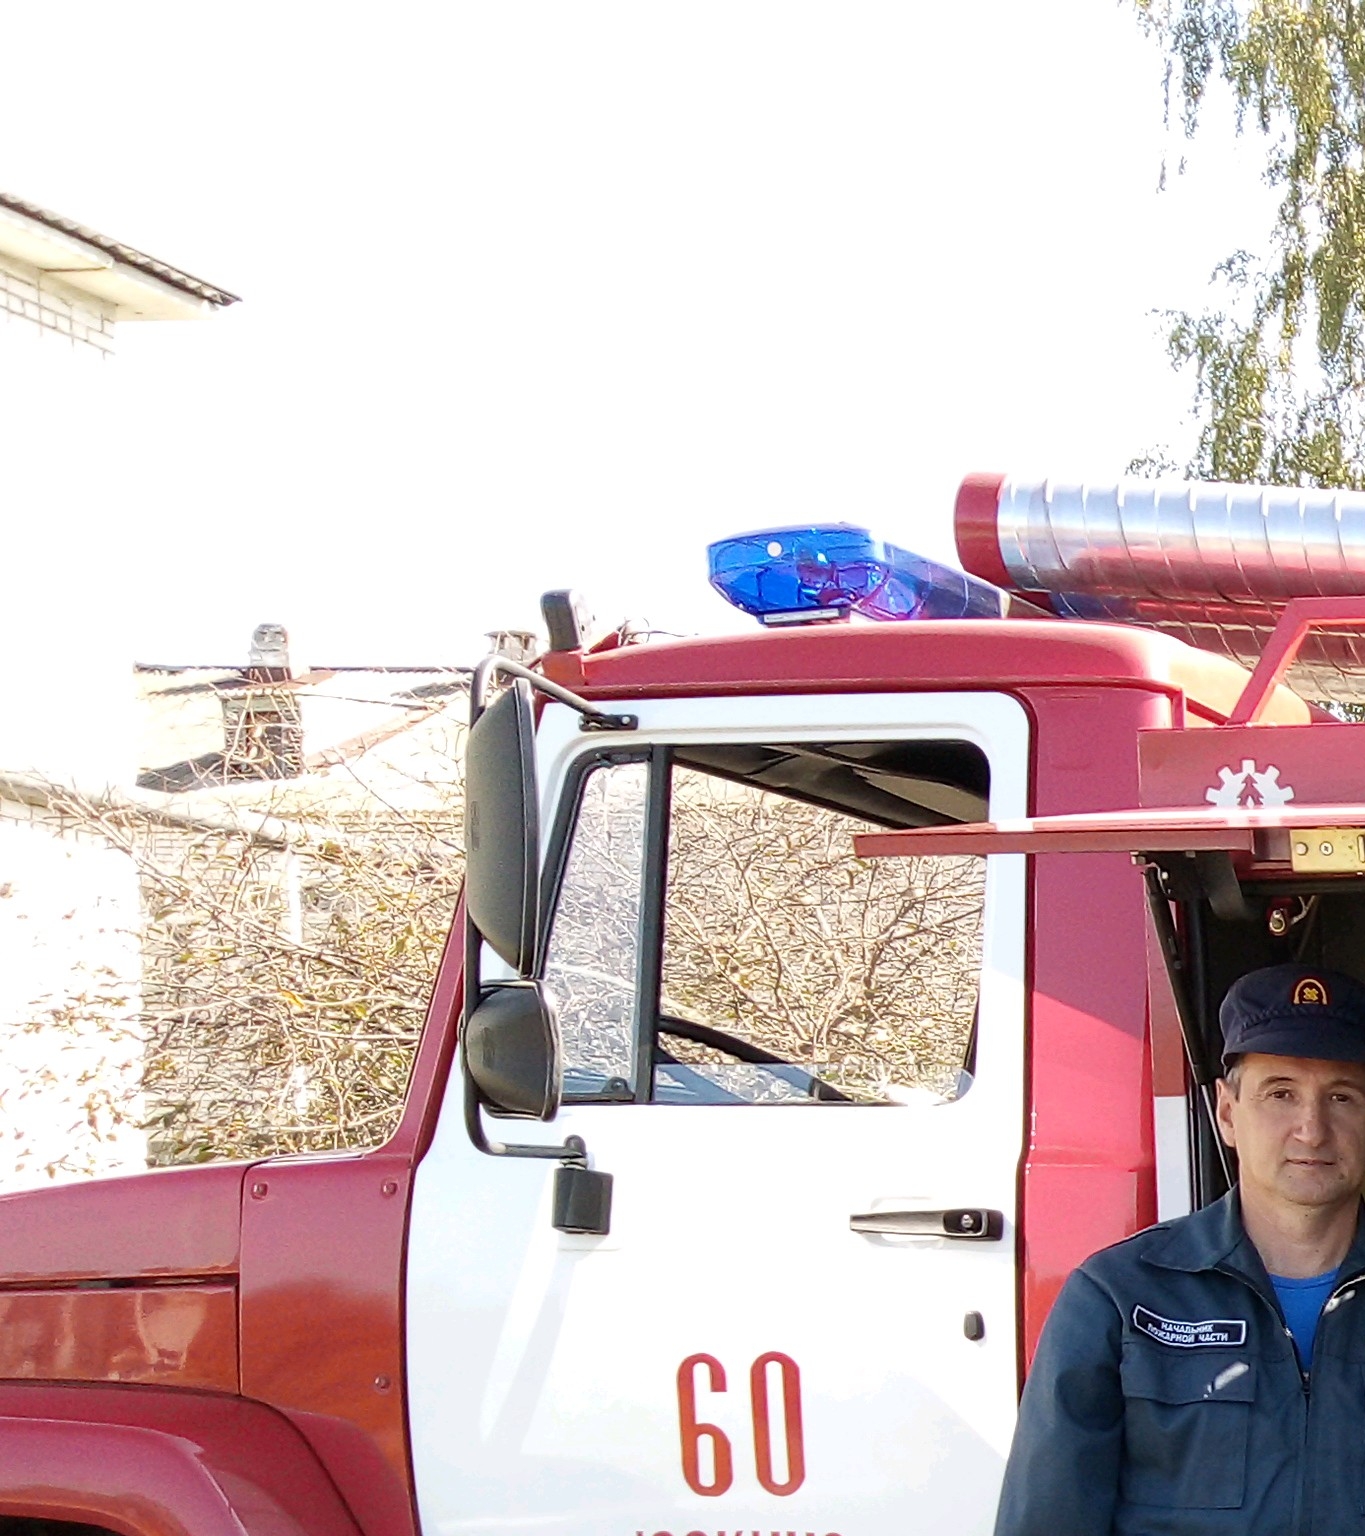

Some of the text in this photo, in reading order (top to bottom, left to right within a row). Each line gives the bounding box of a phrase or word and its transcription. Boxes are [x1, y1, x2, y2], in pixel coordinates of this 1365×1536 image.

[1147, 1322, 1229, 1343] ПОЖАРНОЙ ЧАСТИ
[1160, 1321, 1214, 1334] НАЧАЛЬНИК
[675, 1351, 806, 1497] 60
